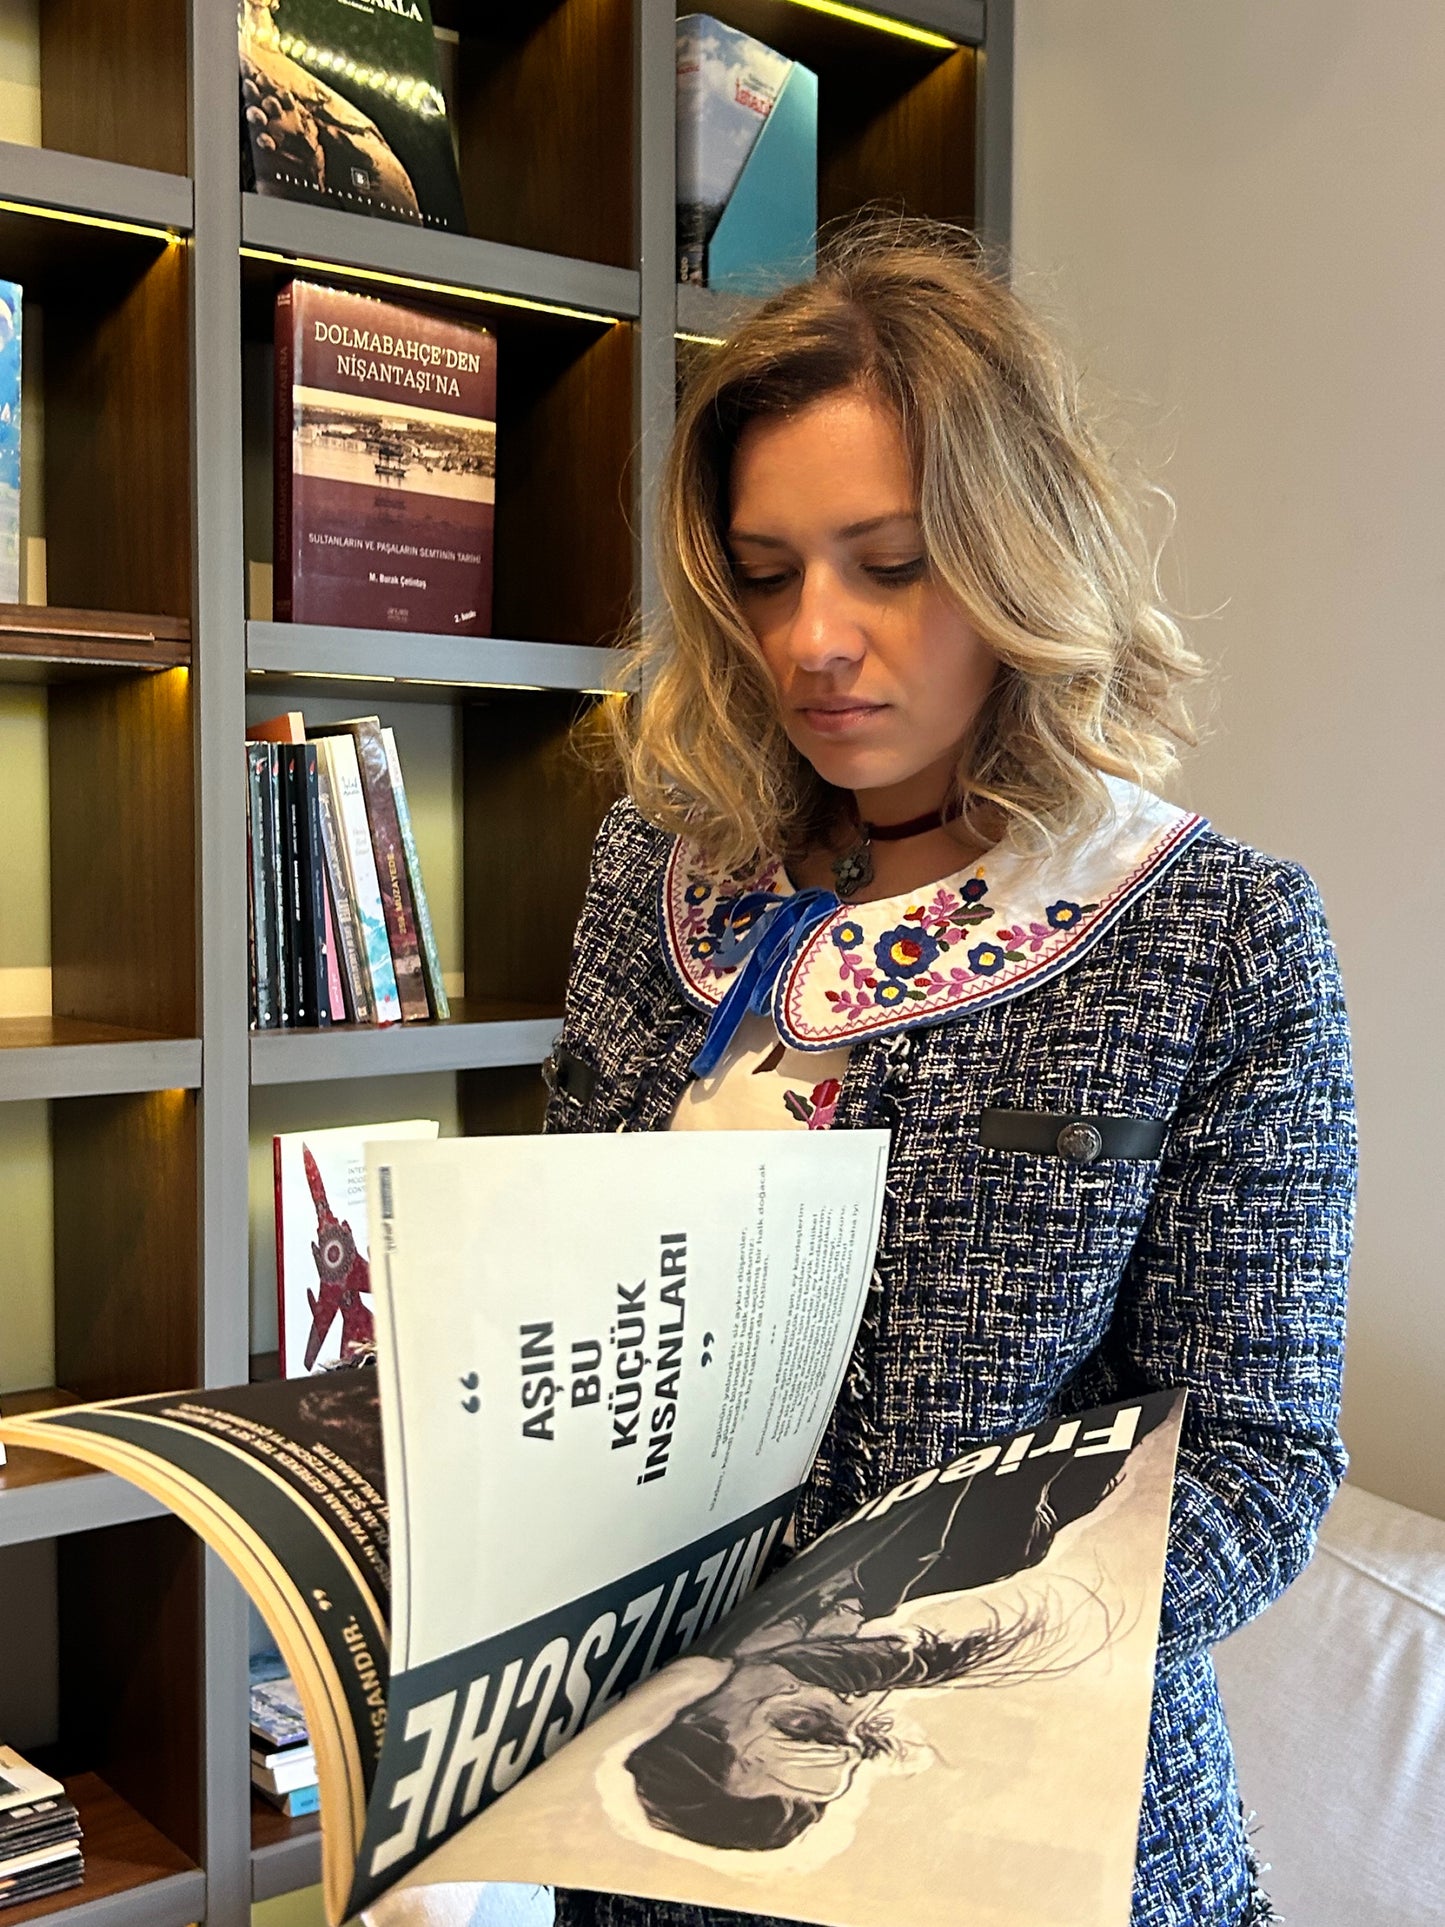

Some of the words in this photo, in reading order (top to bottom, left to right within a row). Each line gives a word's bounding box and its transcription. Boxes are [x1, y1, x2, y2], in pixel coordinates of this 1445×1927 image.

[315, 321, 481, 373] DOLMABAHÇE'DEN
[337, 354, 461, 397] NİŞANTAŞI'NA
[309, 532, 363, 549] SULTANLARIN
[365, 542, 375, 551] VE
[377, 543, 418, 556] PAŞALARIN
[369, 572, 379, 582] M.
[379, 573, 399, 584] Burak
[711, 1402, 727, 1458] Bugünün
[737, 1226, 748, 1283] düşenler,
[720, 1435, 733, 1469] kendi
[729, 1390, 743, 1434] kendini
[740, 1316, 755, 1388] seçenlerden
[751, 1266, 761, 1313] seçilmiş
[758, 1164, 766, 1214] doğacak
[739, 1311, 748, 1337] halk
[571, 1339, 603, 1408] BU
[608, 1279, 652, 1450] KÜÇÜK
[636, 1232, 688, 1486] İNSANLARI
[736, 1342, 744, 1357] bir
[748, 1329, 761, 1376] halktan
[520, 1321, 565, 1441] AŞIN
[729, 1359, 741, 1402] birinde
[371, 1517, 782, 1877] NIETZSCHE
